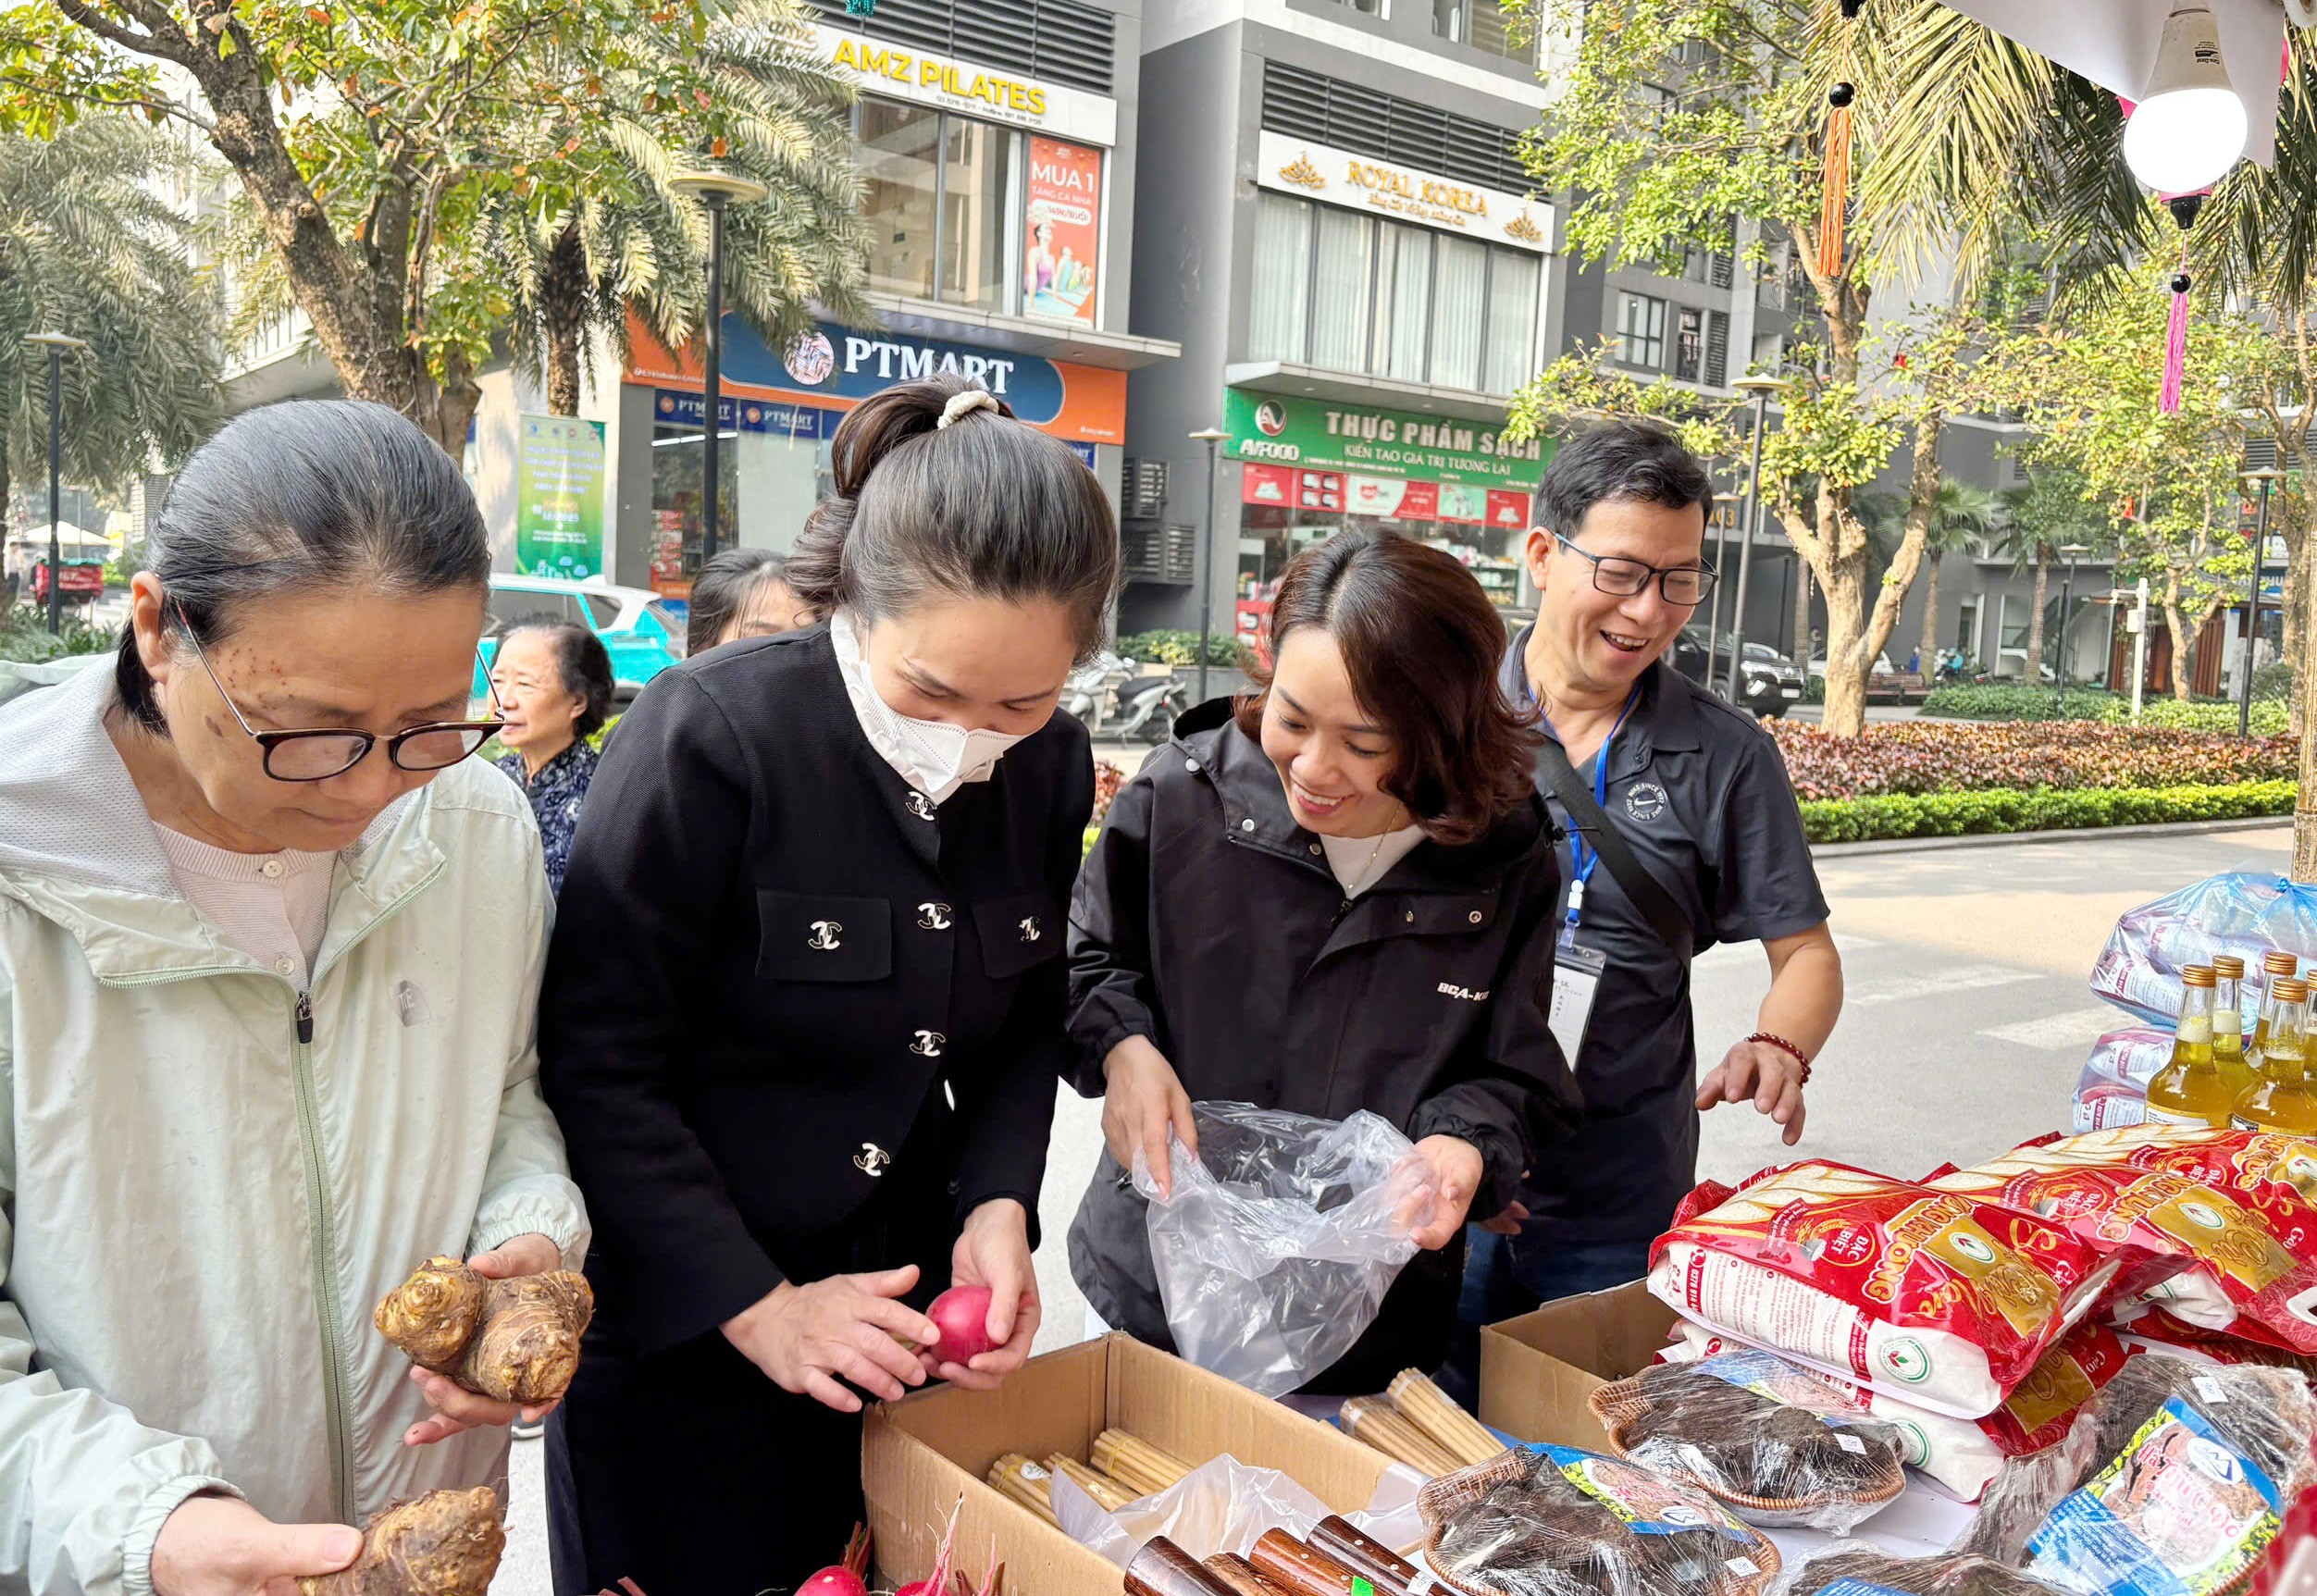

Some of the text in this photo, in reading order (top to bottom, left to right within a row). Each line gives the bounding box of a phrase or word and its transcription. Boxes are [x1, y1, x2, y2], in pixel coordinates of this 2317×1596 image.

[835, 39, 1046, 115] AMZ PILATES
[1032, 160, 1094, 192] MUA 1
[1346, 159, 1414, 199] ROYAL
[1419, 179, 1488, 218] KOREA
[844, 336, 1014, 394] PTMART
[1326, 411, 1541, 461] THỰC PHẨM SẠCH
[1492, 464, 1511, 476] LAI
[1831, 1231, 1853, 1255] BIỆT
[1848, 1235, 1869, 1261] ĐẶC
[2138, 1442, 2164, 1468] Hà
